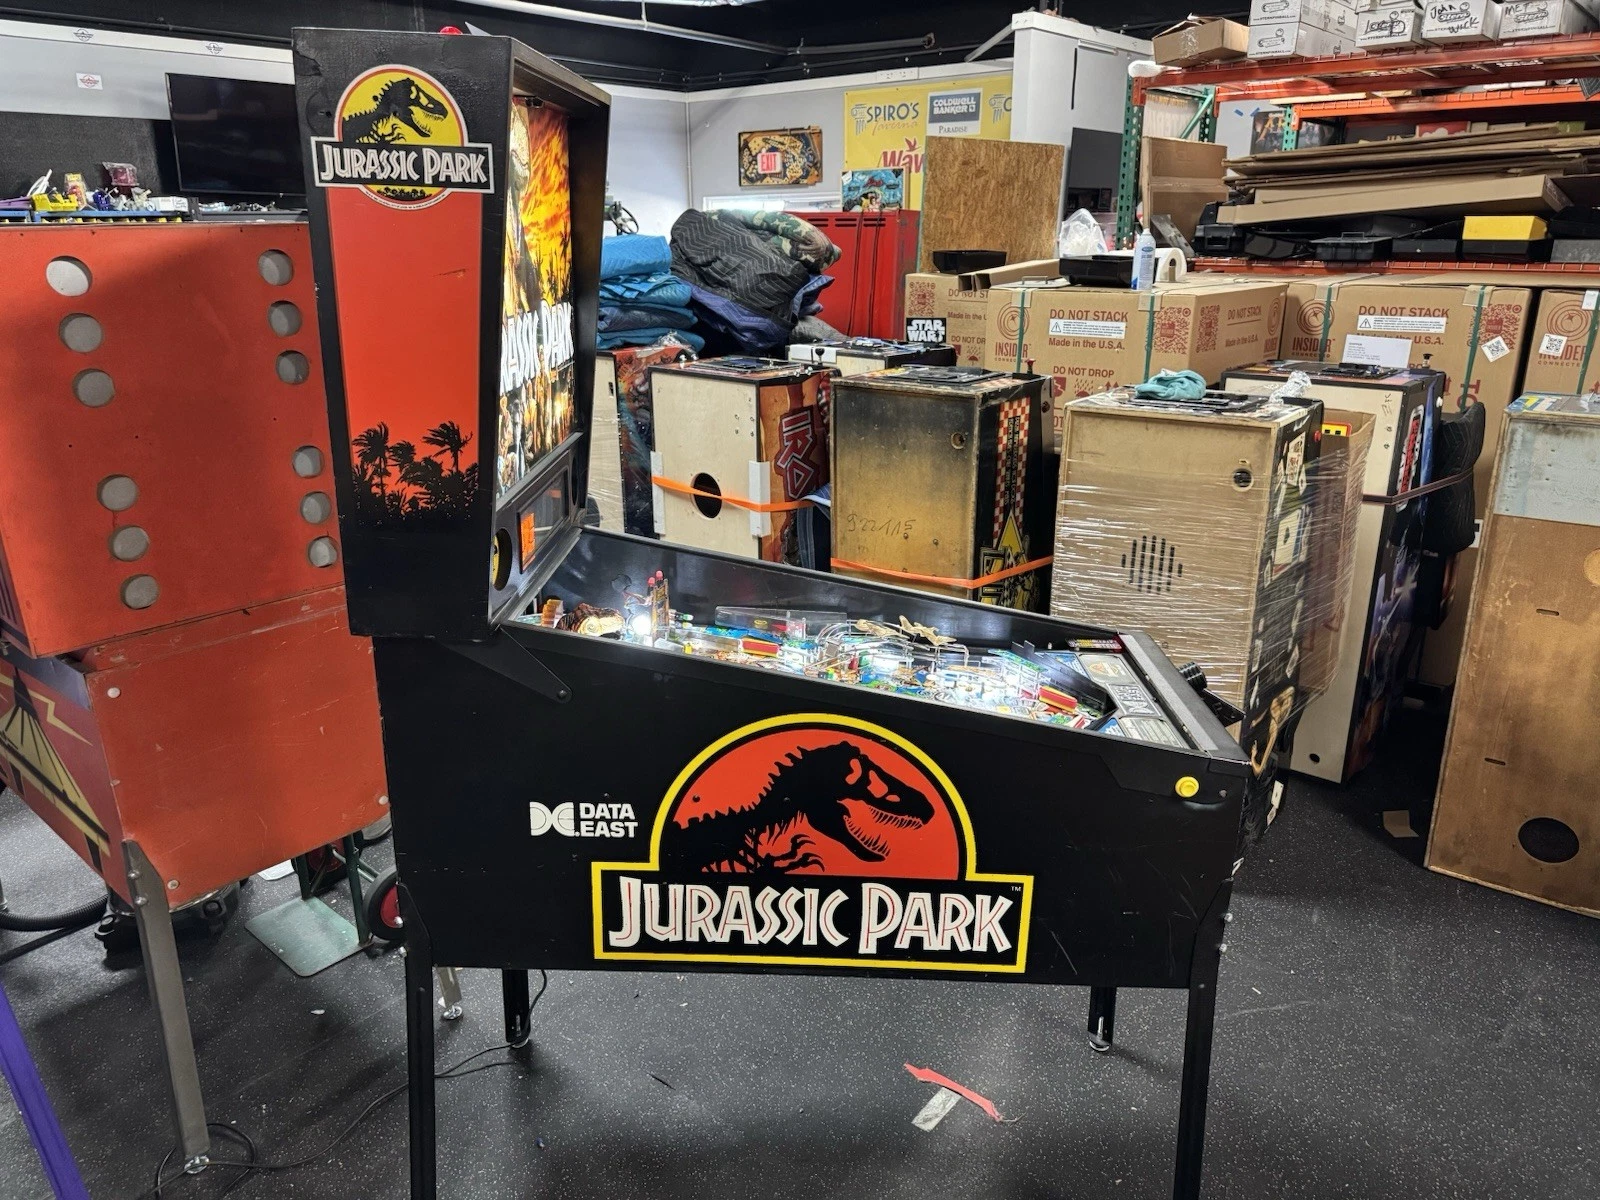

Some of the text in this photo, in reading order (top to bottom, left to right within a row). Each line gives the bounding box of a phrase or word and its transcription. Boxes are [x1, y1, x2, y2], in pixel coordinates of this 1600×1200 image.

[1430, 4, 1457, 20] John
[933, 96, 977, 107] COLDWELL
[866, 102, 920, 123] SPIRO'S
[933, 104, 968, 115] BANKER
[321, 143, 488, 184] JURASSIC PARK
[761, 153, 777, 172] EXIT
[948, 288, 959, 297] DO
[1049, 308, 1129, 322] DO NOT STACK
[1359, 305, 1450, 318] DO NOT STACK
[907, 319, 945, 331] STAR
[907, 330, 946, 342] WARS
[951, 335, 987, 345] DO NOT DR
[1413, 335, 1444, 346] U.S.A.
[994, 341, 1029, 358] INSIDR
[1048, 337, 1126, 350] Made in the U.S.A.
[1292, 336, 1332, 353] INSIDR
[1053, 365, 1115, 379] DO NOT DROP
[777, 410, 815, 499] IRO
[579, 802, 636, 820] DATA
[580, 820, 639, 838] EAST
[609, 876, 849, 947] JURASSIC
[858, 882, 1014, 954] PARK
